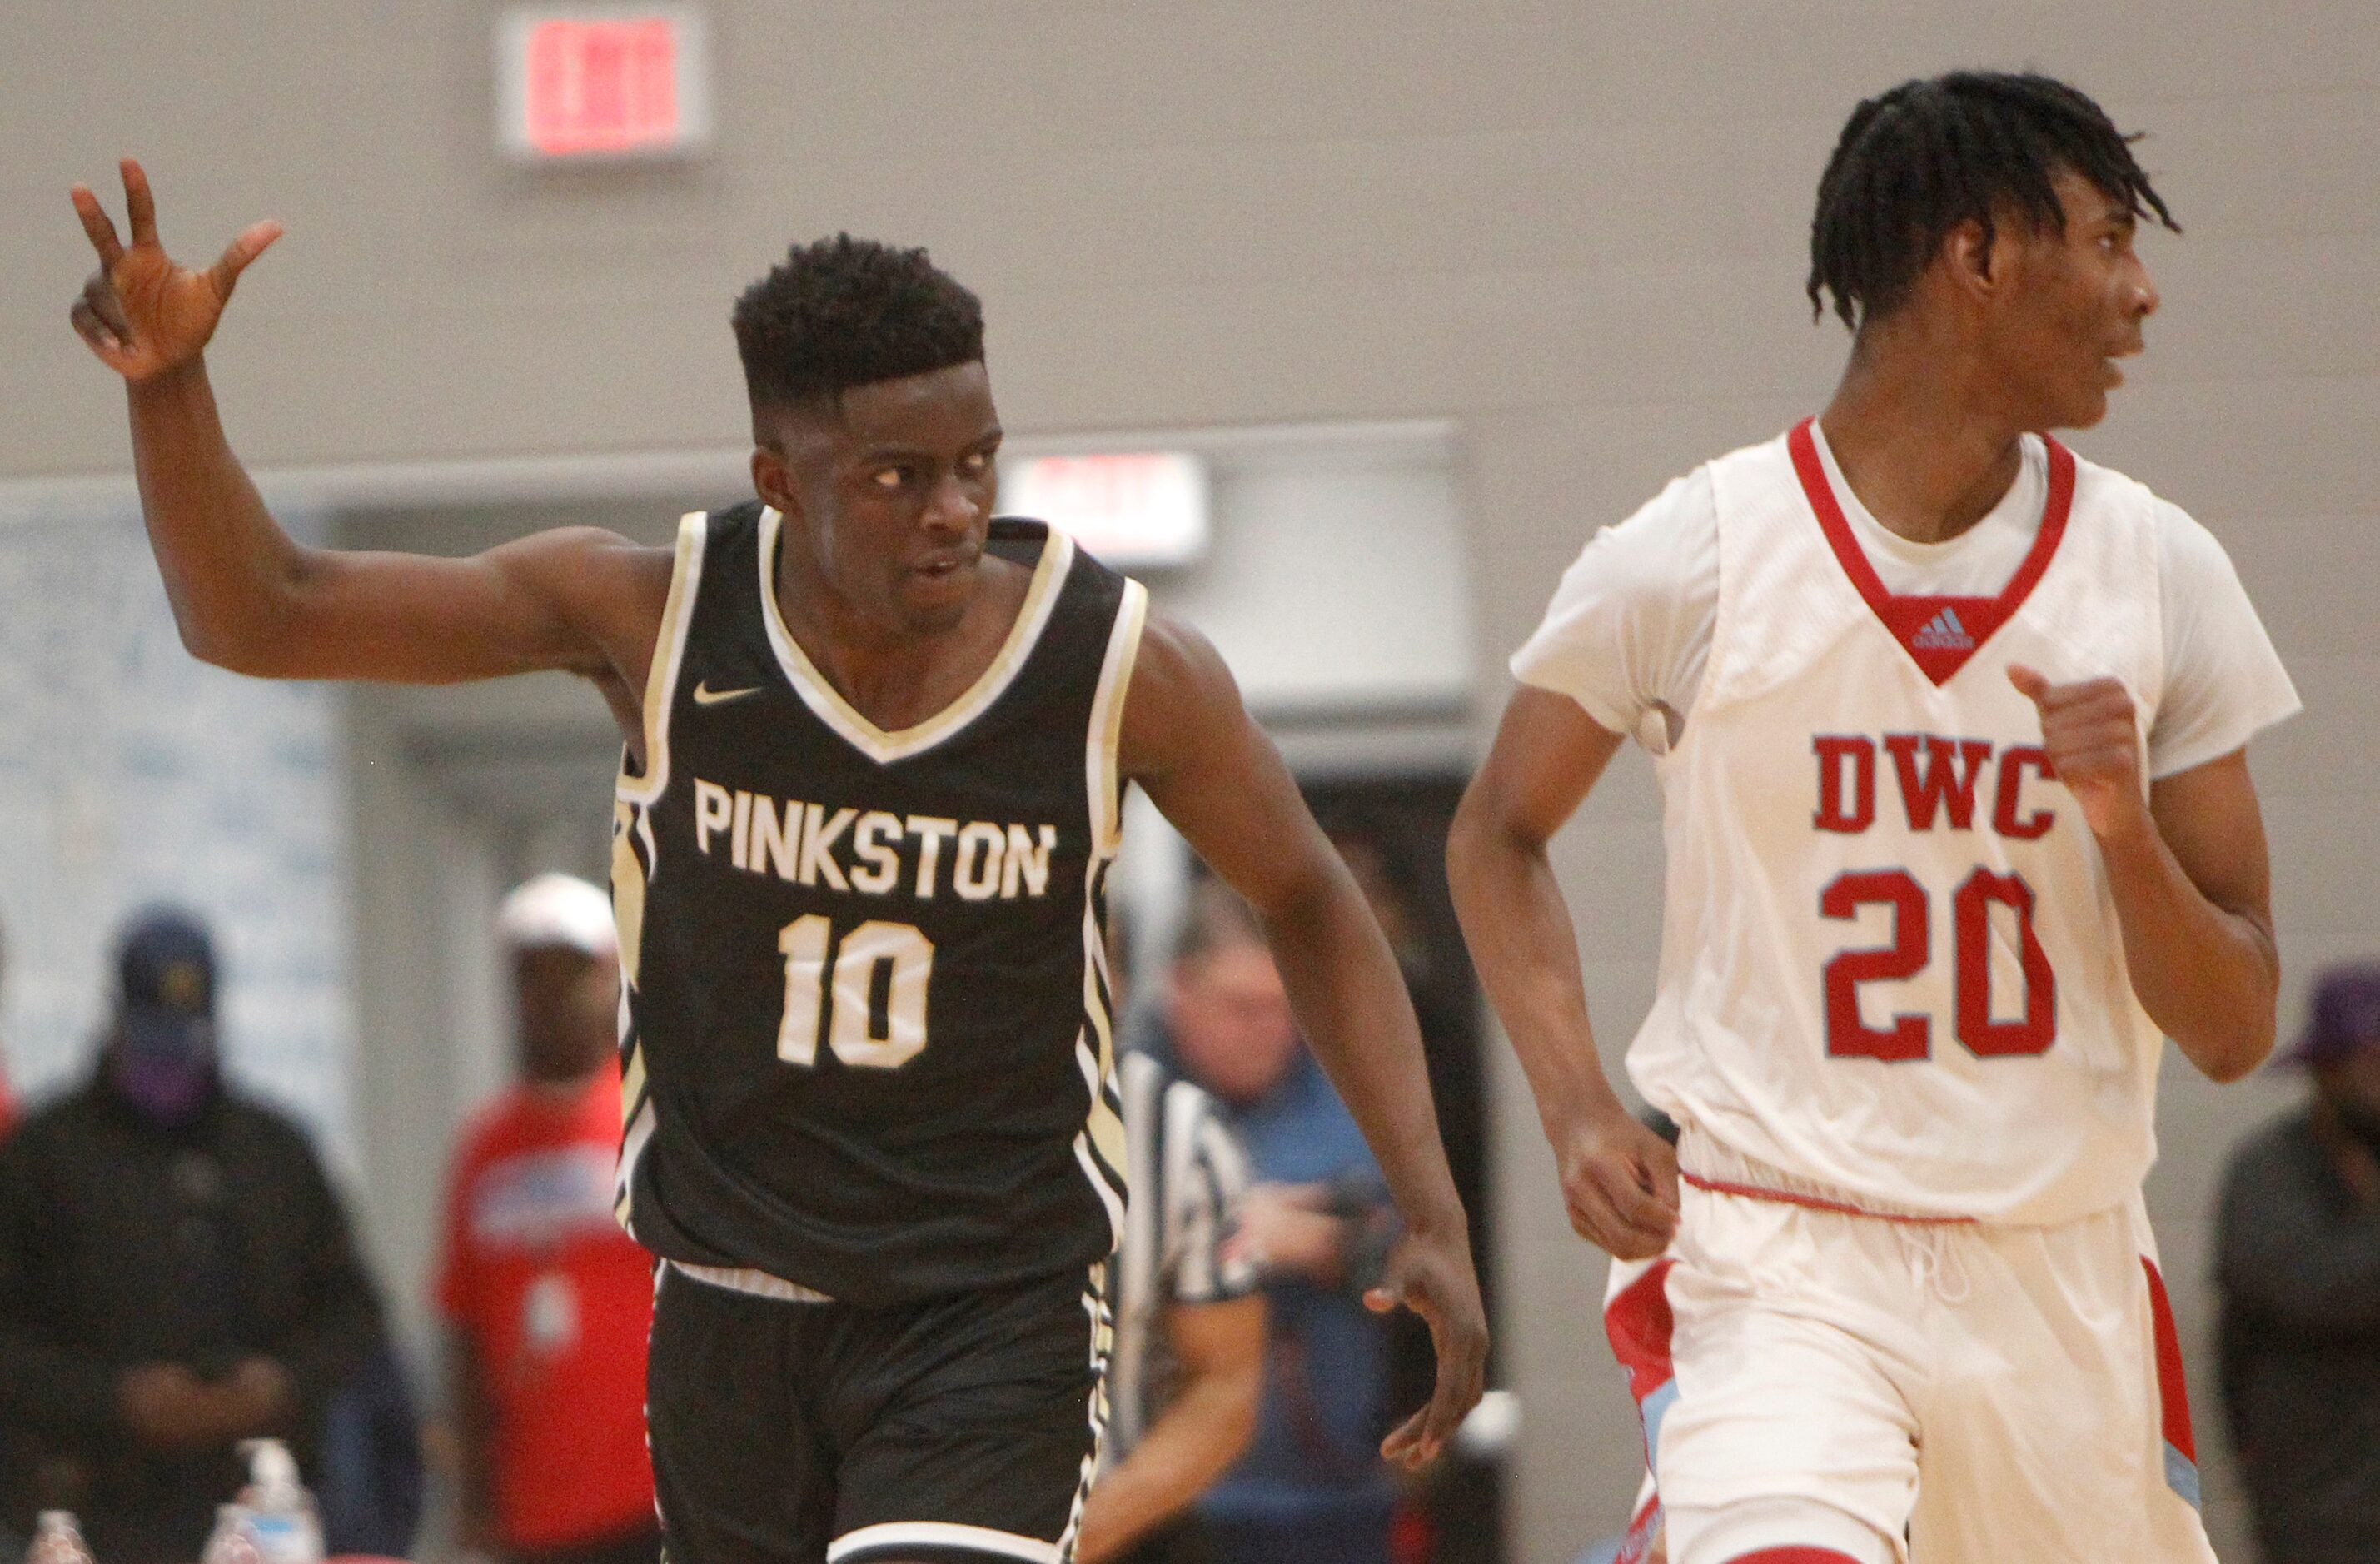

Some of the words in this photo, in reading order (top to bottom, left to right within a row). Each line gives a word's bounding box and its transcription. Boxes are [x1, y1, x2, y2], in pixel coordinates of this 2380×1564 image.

[694, 778, 1056, 900] PINKSTON
[1812, 732, 2056, 839] DWC
[777, 914, 934, 1068] 10
[1818, 864, 2058, 1062] 20
